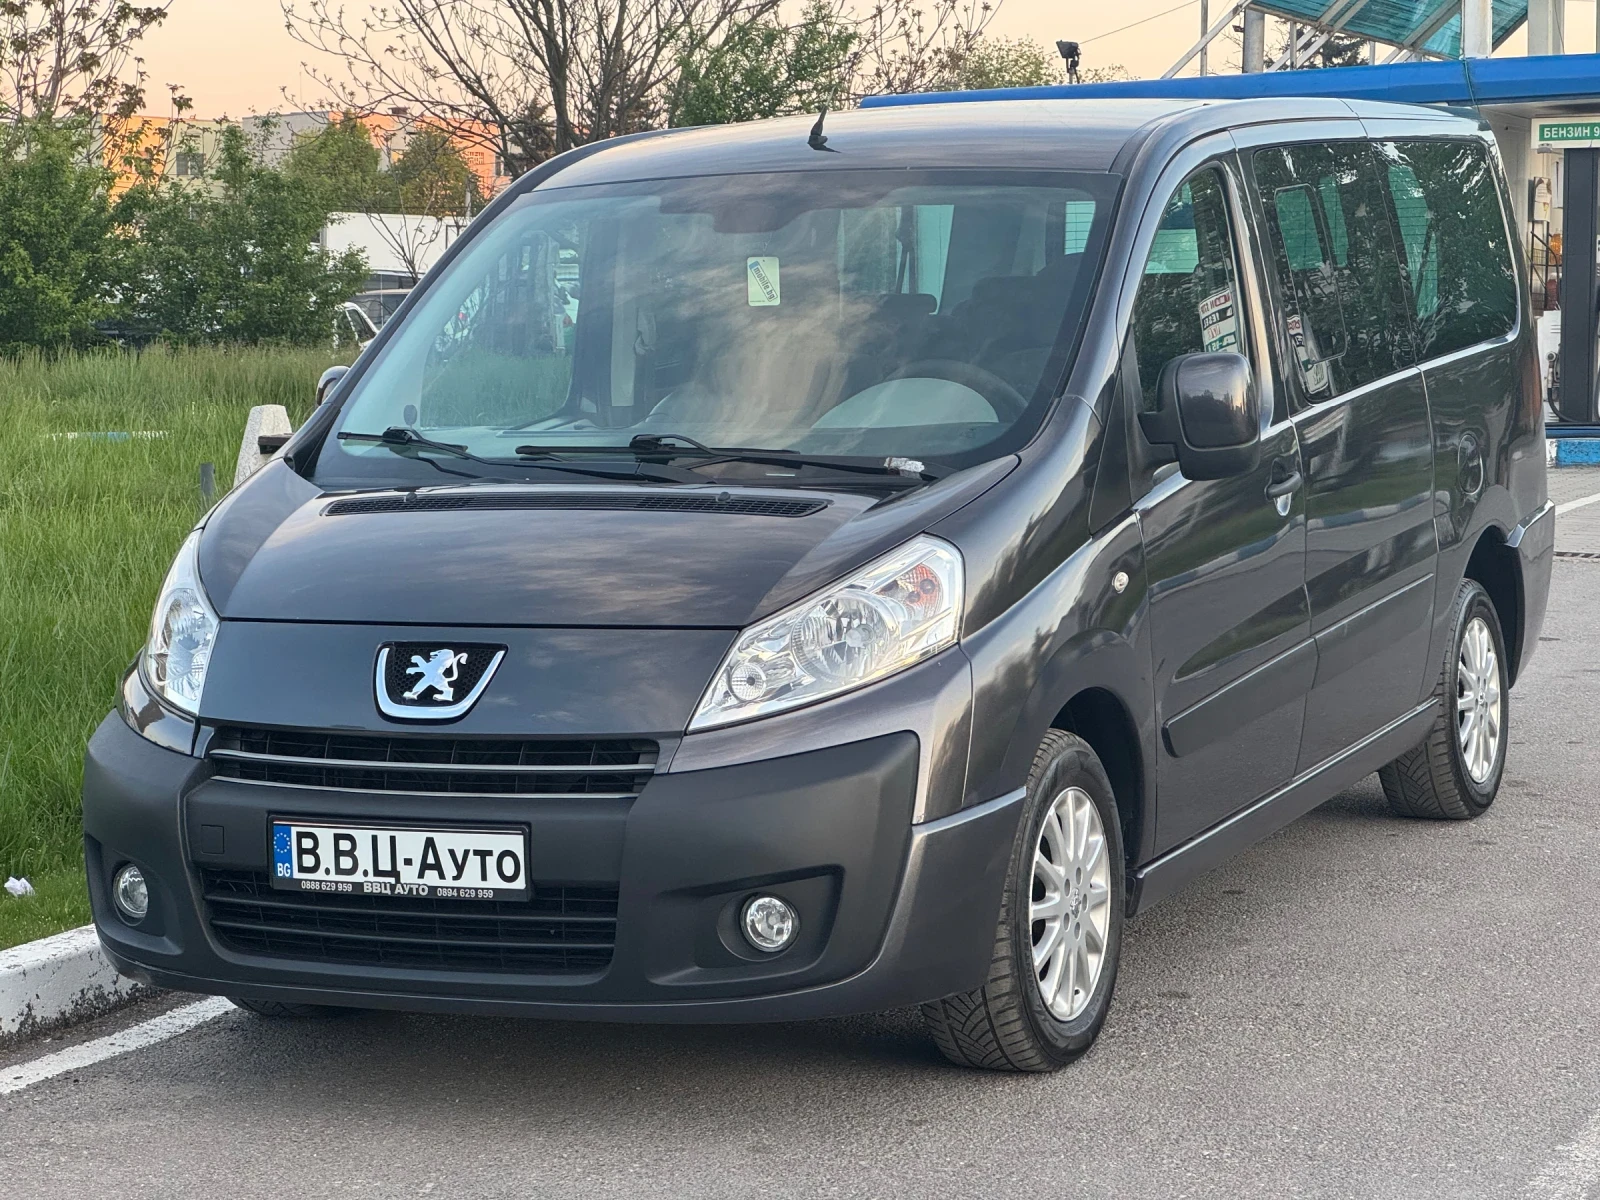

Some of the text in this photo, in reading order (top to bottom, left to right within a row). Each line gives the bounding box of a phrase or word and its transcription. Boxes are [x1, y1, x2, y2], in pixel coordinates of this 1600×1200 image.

[1543, 126, 1590, 138] БЕНЗИН
[296, 831, 521, 884] В.В.Ц-Ауто
[277, 862, 291, 877] BG
[301, 880, 494, 899] 0888 629 959 ВВЦ АУТО 0894 629 959
